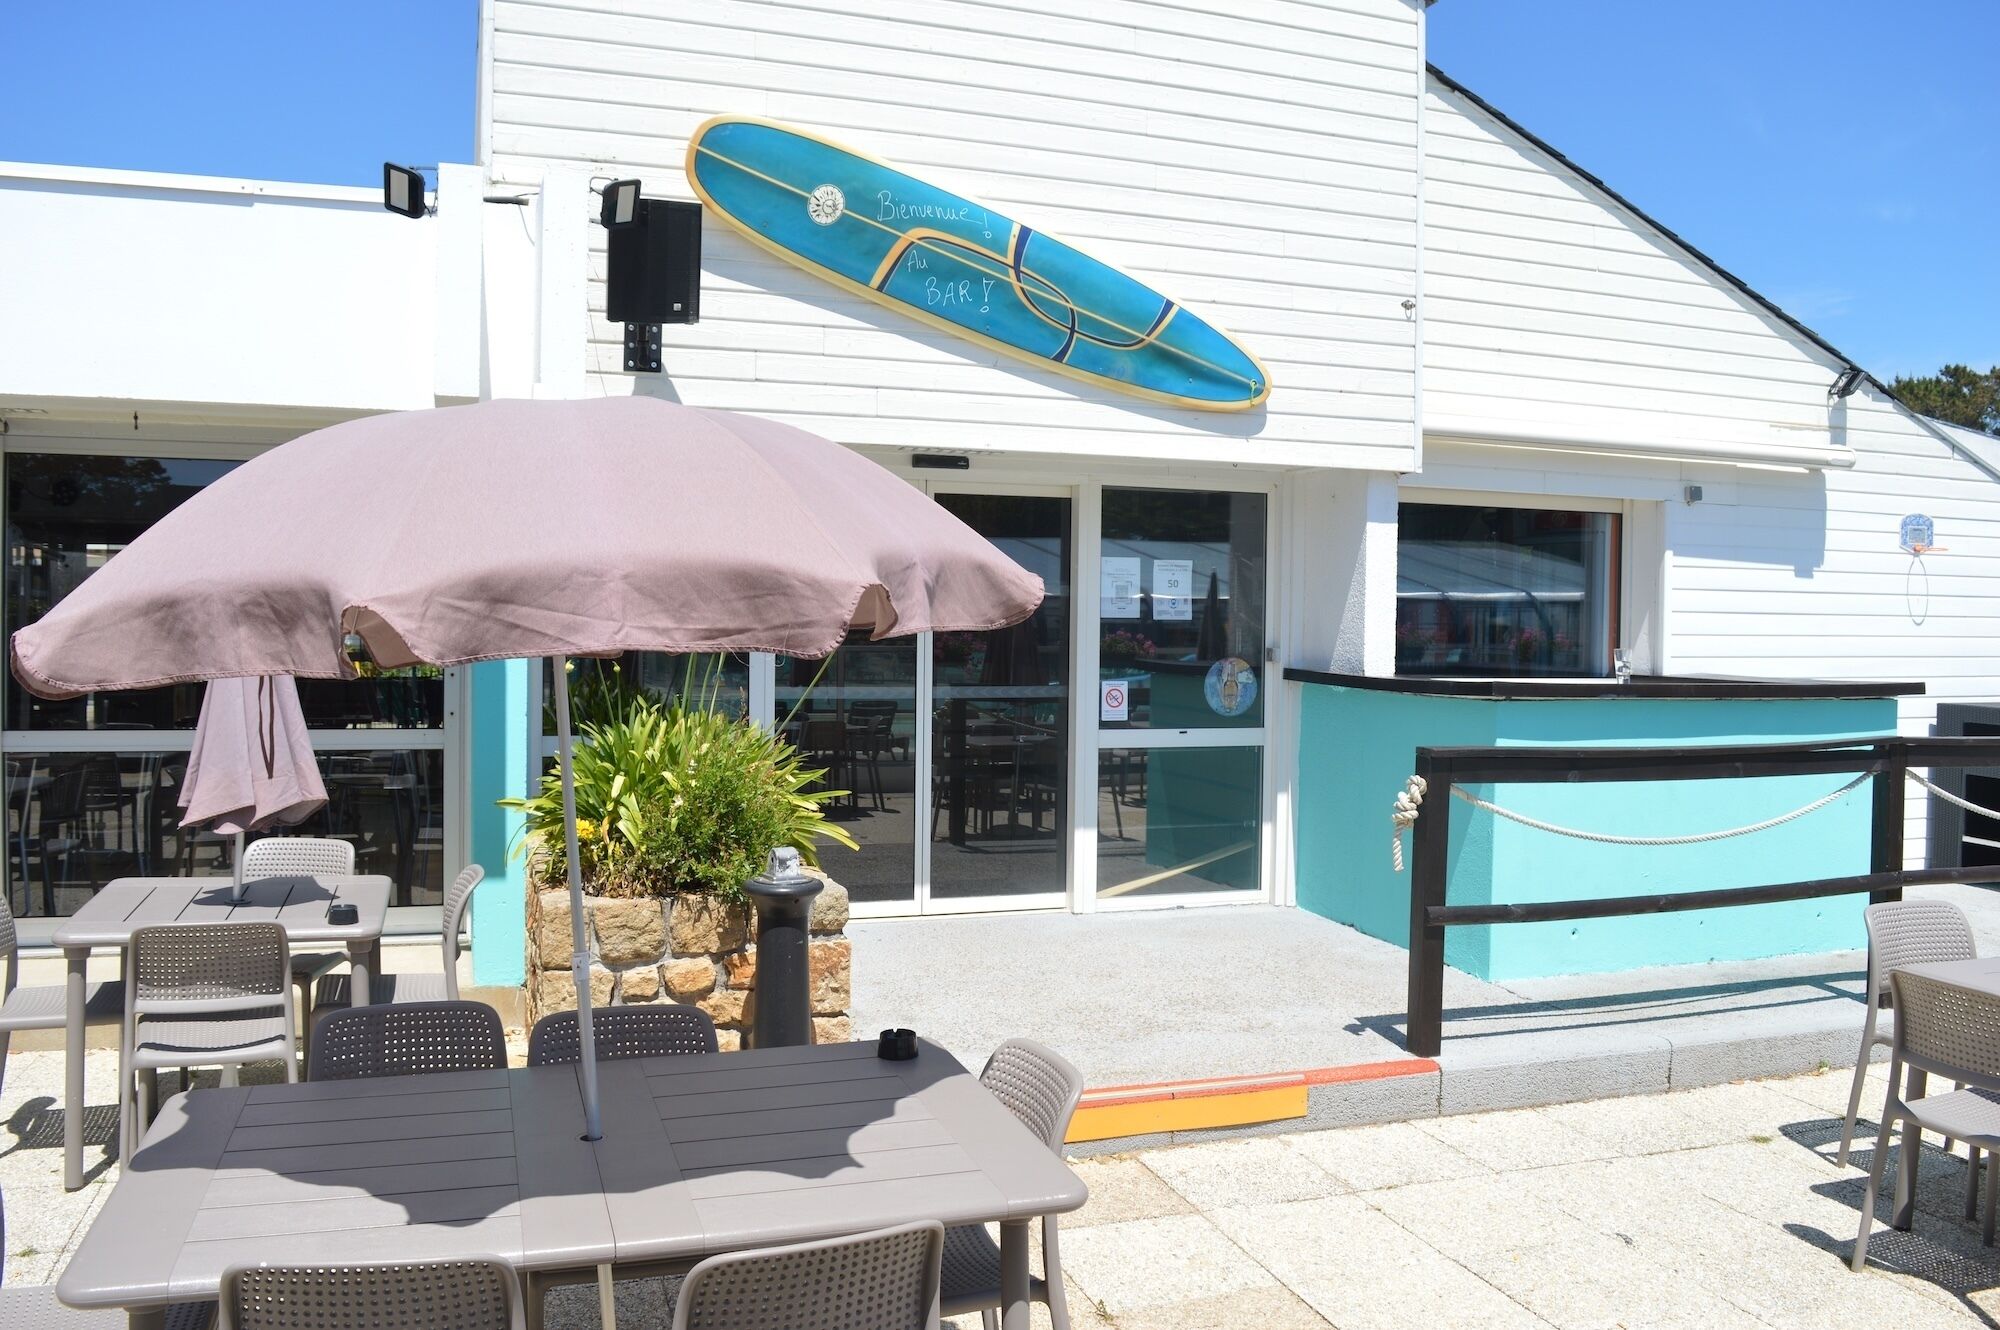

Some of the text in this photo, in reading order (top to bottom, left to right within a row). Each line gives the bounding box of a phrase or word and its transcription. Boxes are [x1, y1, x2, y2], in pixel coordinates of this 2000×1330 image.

[877, 190, 982, 224] Bienvenue
[907, 250, 929, 273] Au
[925, 277, 973, 306] BAR
[1168, 579, 1179, 588] 50
